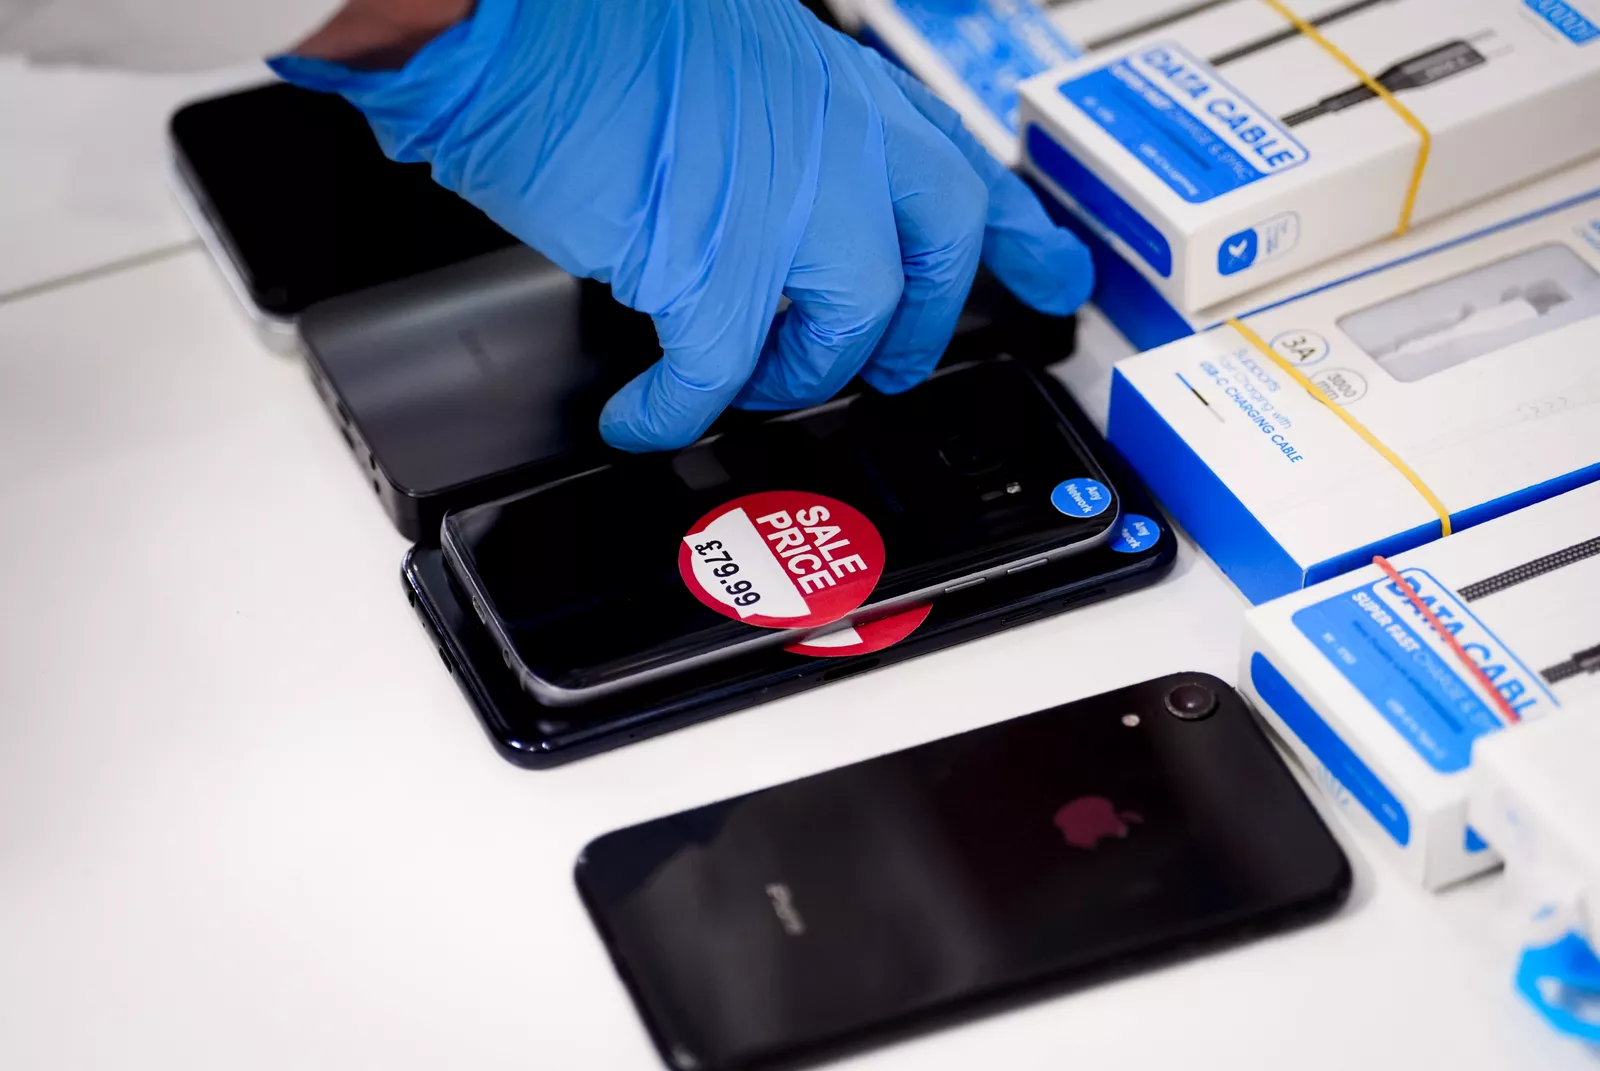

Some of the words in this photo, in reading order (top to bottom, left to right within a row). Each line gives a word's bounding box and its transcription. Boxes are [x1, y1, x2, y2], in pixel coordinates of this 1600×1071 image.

[1142, 48, 1210, 99] DATA
[1205, 98, 1295, 168] CABLE
[1281, 336, 1316, 362] 3A
[1327, 372, 1358, 398] 3000
[1225, 386, 1276, 435] CHARGING
[1271, 434, 1304, 464] CABLE
[1064, 483, 1094, 514] Network
[1085, 486, 1103, 501] Any
[756, 509, 837, 595] PRICE
[796, 505, 868, 579] SALE
[1121, 528, 1142, 550] work
[1132, 521, 1151, 537] Any
[694, 539, 762, 607] £79.99
[1352, 591, 1394, 628] SUPER
[1385, 622, 1422, 653] FAST
